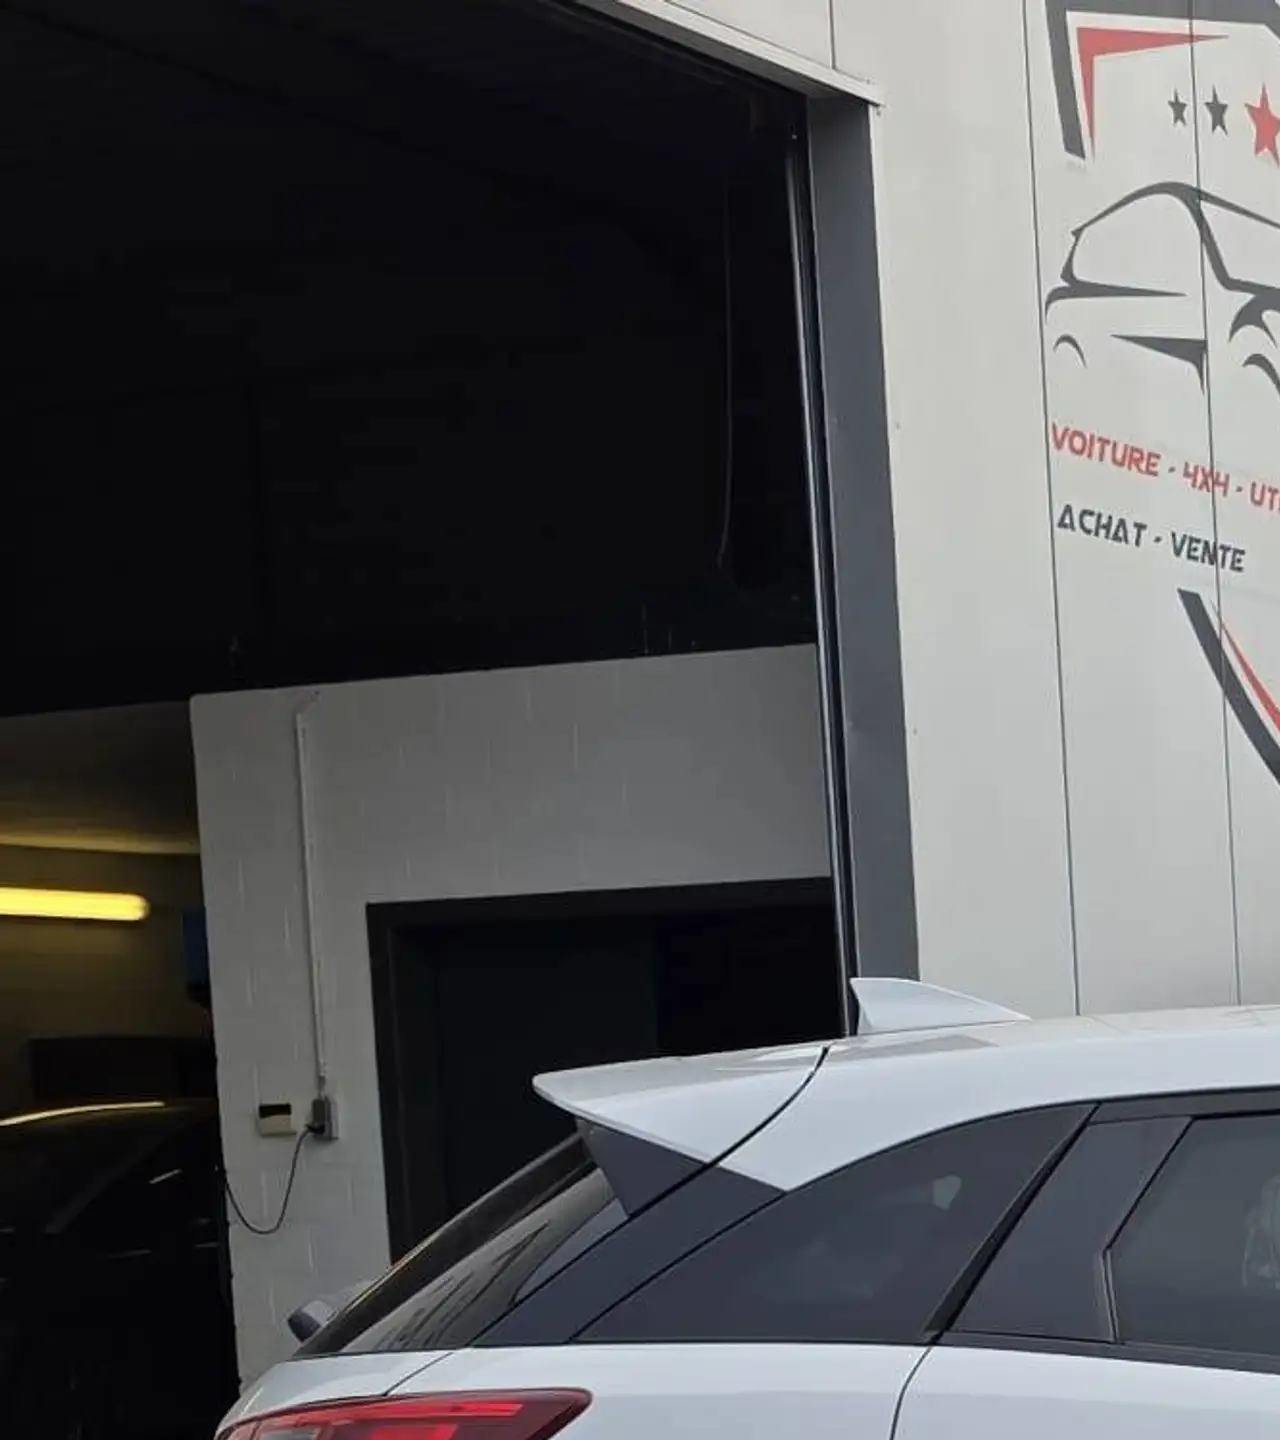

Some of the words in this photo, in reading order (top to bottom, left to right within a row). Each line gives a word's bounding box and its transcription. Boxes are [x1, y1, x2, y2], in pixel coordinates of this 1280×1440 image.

[1051, 421, 1161, 477] VOITURE
[1056, 504, 1148, 547] ACHAT
[1171, 531, 1246, 573] VENTE
